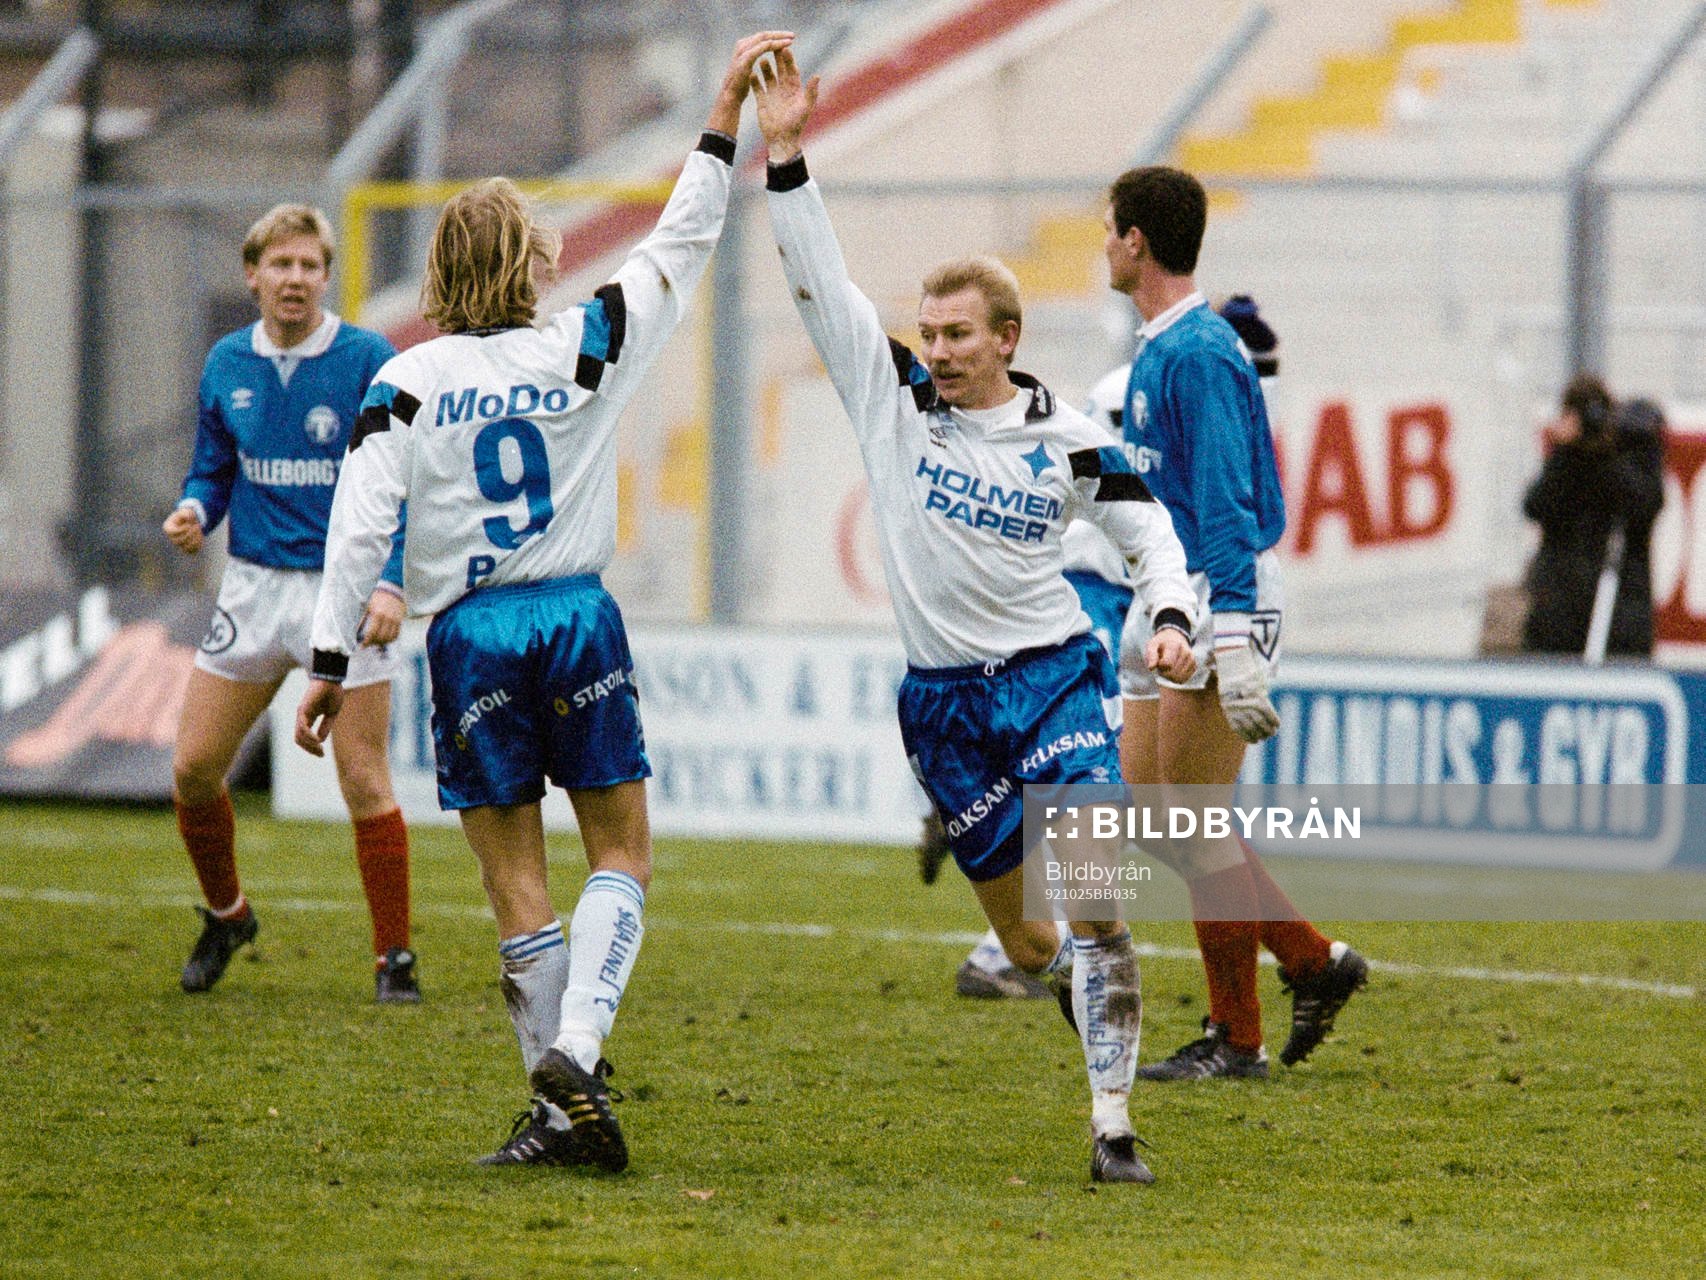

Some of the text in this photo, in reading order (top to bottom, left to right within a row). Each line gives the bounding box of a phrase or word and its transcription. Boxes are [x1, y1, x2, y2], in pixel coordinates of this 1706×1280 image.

[435, 383, 569, 427] MoDo
[238, 449, 342, 487] ELLEBORG
[473, 417, 554, 550] 9
[916, 456, 1065, 521] HOLMEN
[925, 489, 1048, 543] PAPER
